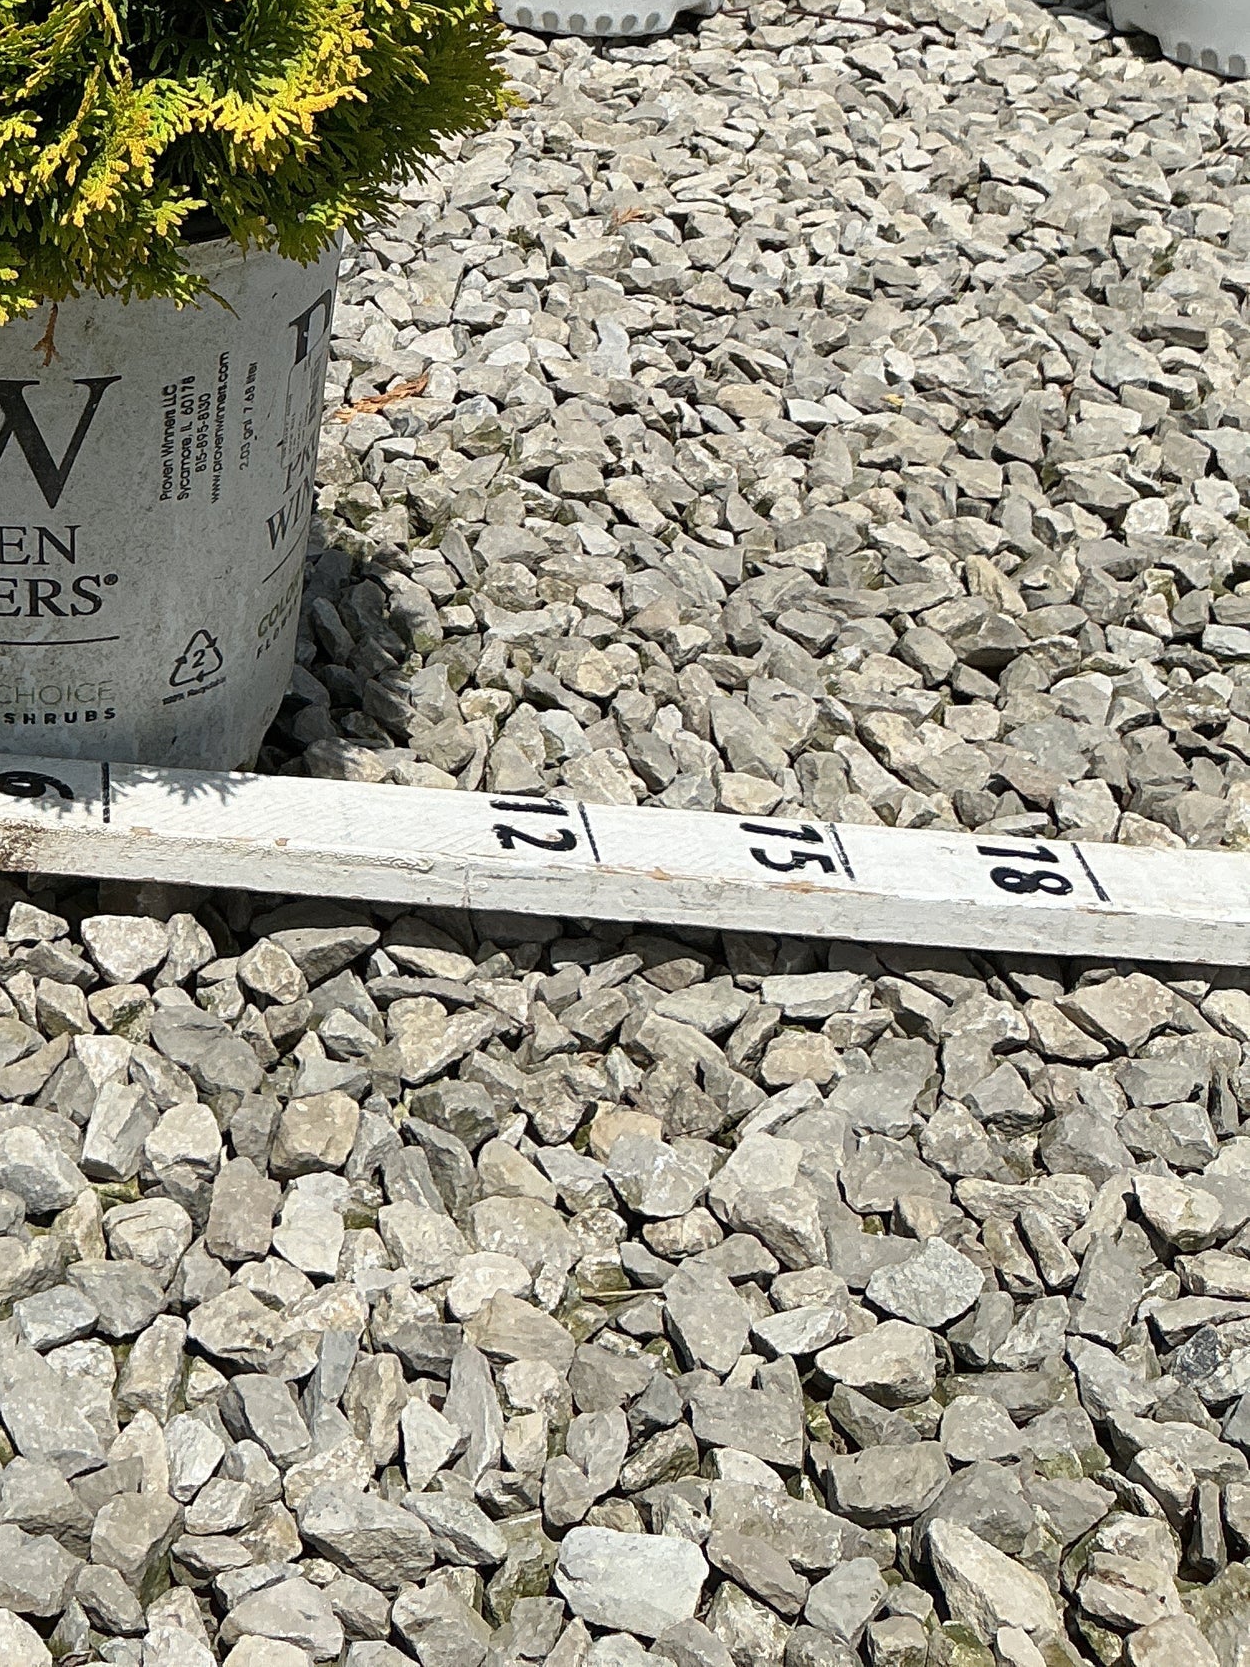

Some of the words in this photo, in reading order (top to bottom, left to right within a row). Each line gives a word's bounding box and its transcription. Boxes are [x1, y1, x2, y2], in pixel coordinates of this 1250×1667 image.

[162, 383, 178, 408] LLC
[180, 375, 195, 416] 60178
[243, 387, 255, 414] 7.68
[161, 408, 177, 458] Winners
[180, 421, 193, 432] IL
[195, 392, 211, 473] 815-895-8130
[209, 350, 230, 504] www.provenwinners.com
[177, 433, 193, 501] Sycamore,
[239, 441, 251, 471] 2.03
[159, 458, 175, 502] Proven
[3, 707, 117, 726] SHRUBS
[489, 797, 577, 851] 12
[739, 821, 837, 873] 15
[975, 844, 1074, 896] 18
